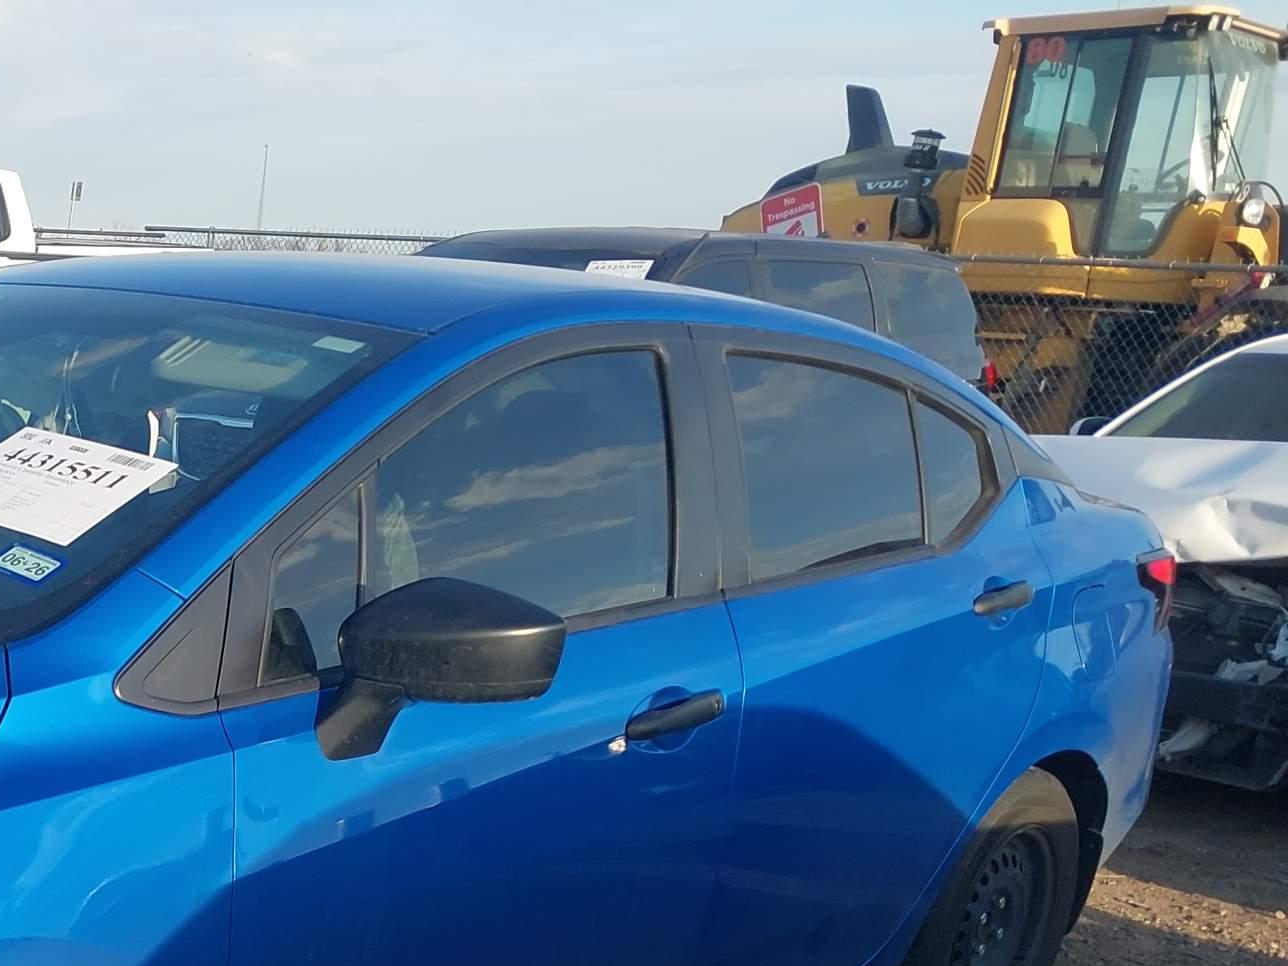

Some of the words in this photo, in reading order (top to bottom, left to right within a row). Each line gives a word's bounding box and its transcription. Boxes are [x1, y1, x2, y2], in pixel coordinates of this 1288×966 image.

[865, 177, 932, 191] VOLO
[783, 196, 797, 207] No
[767, 201, 816, 224] Trespassing
[3, 447, 129, 489] 44315511
